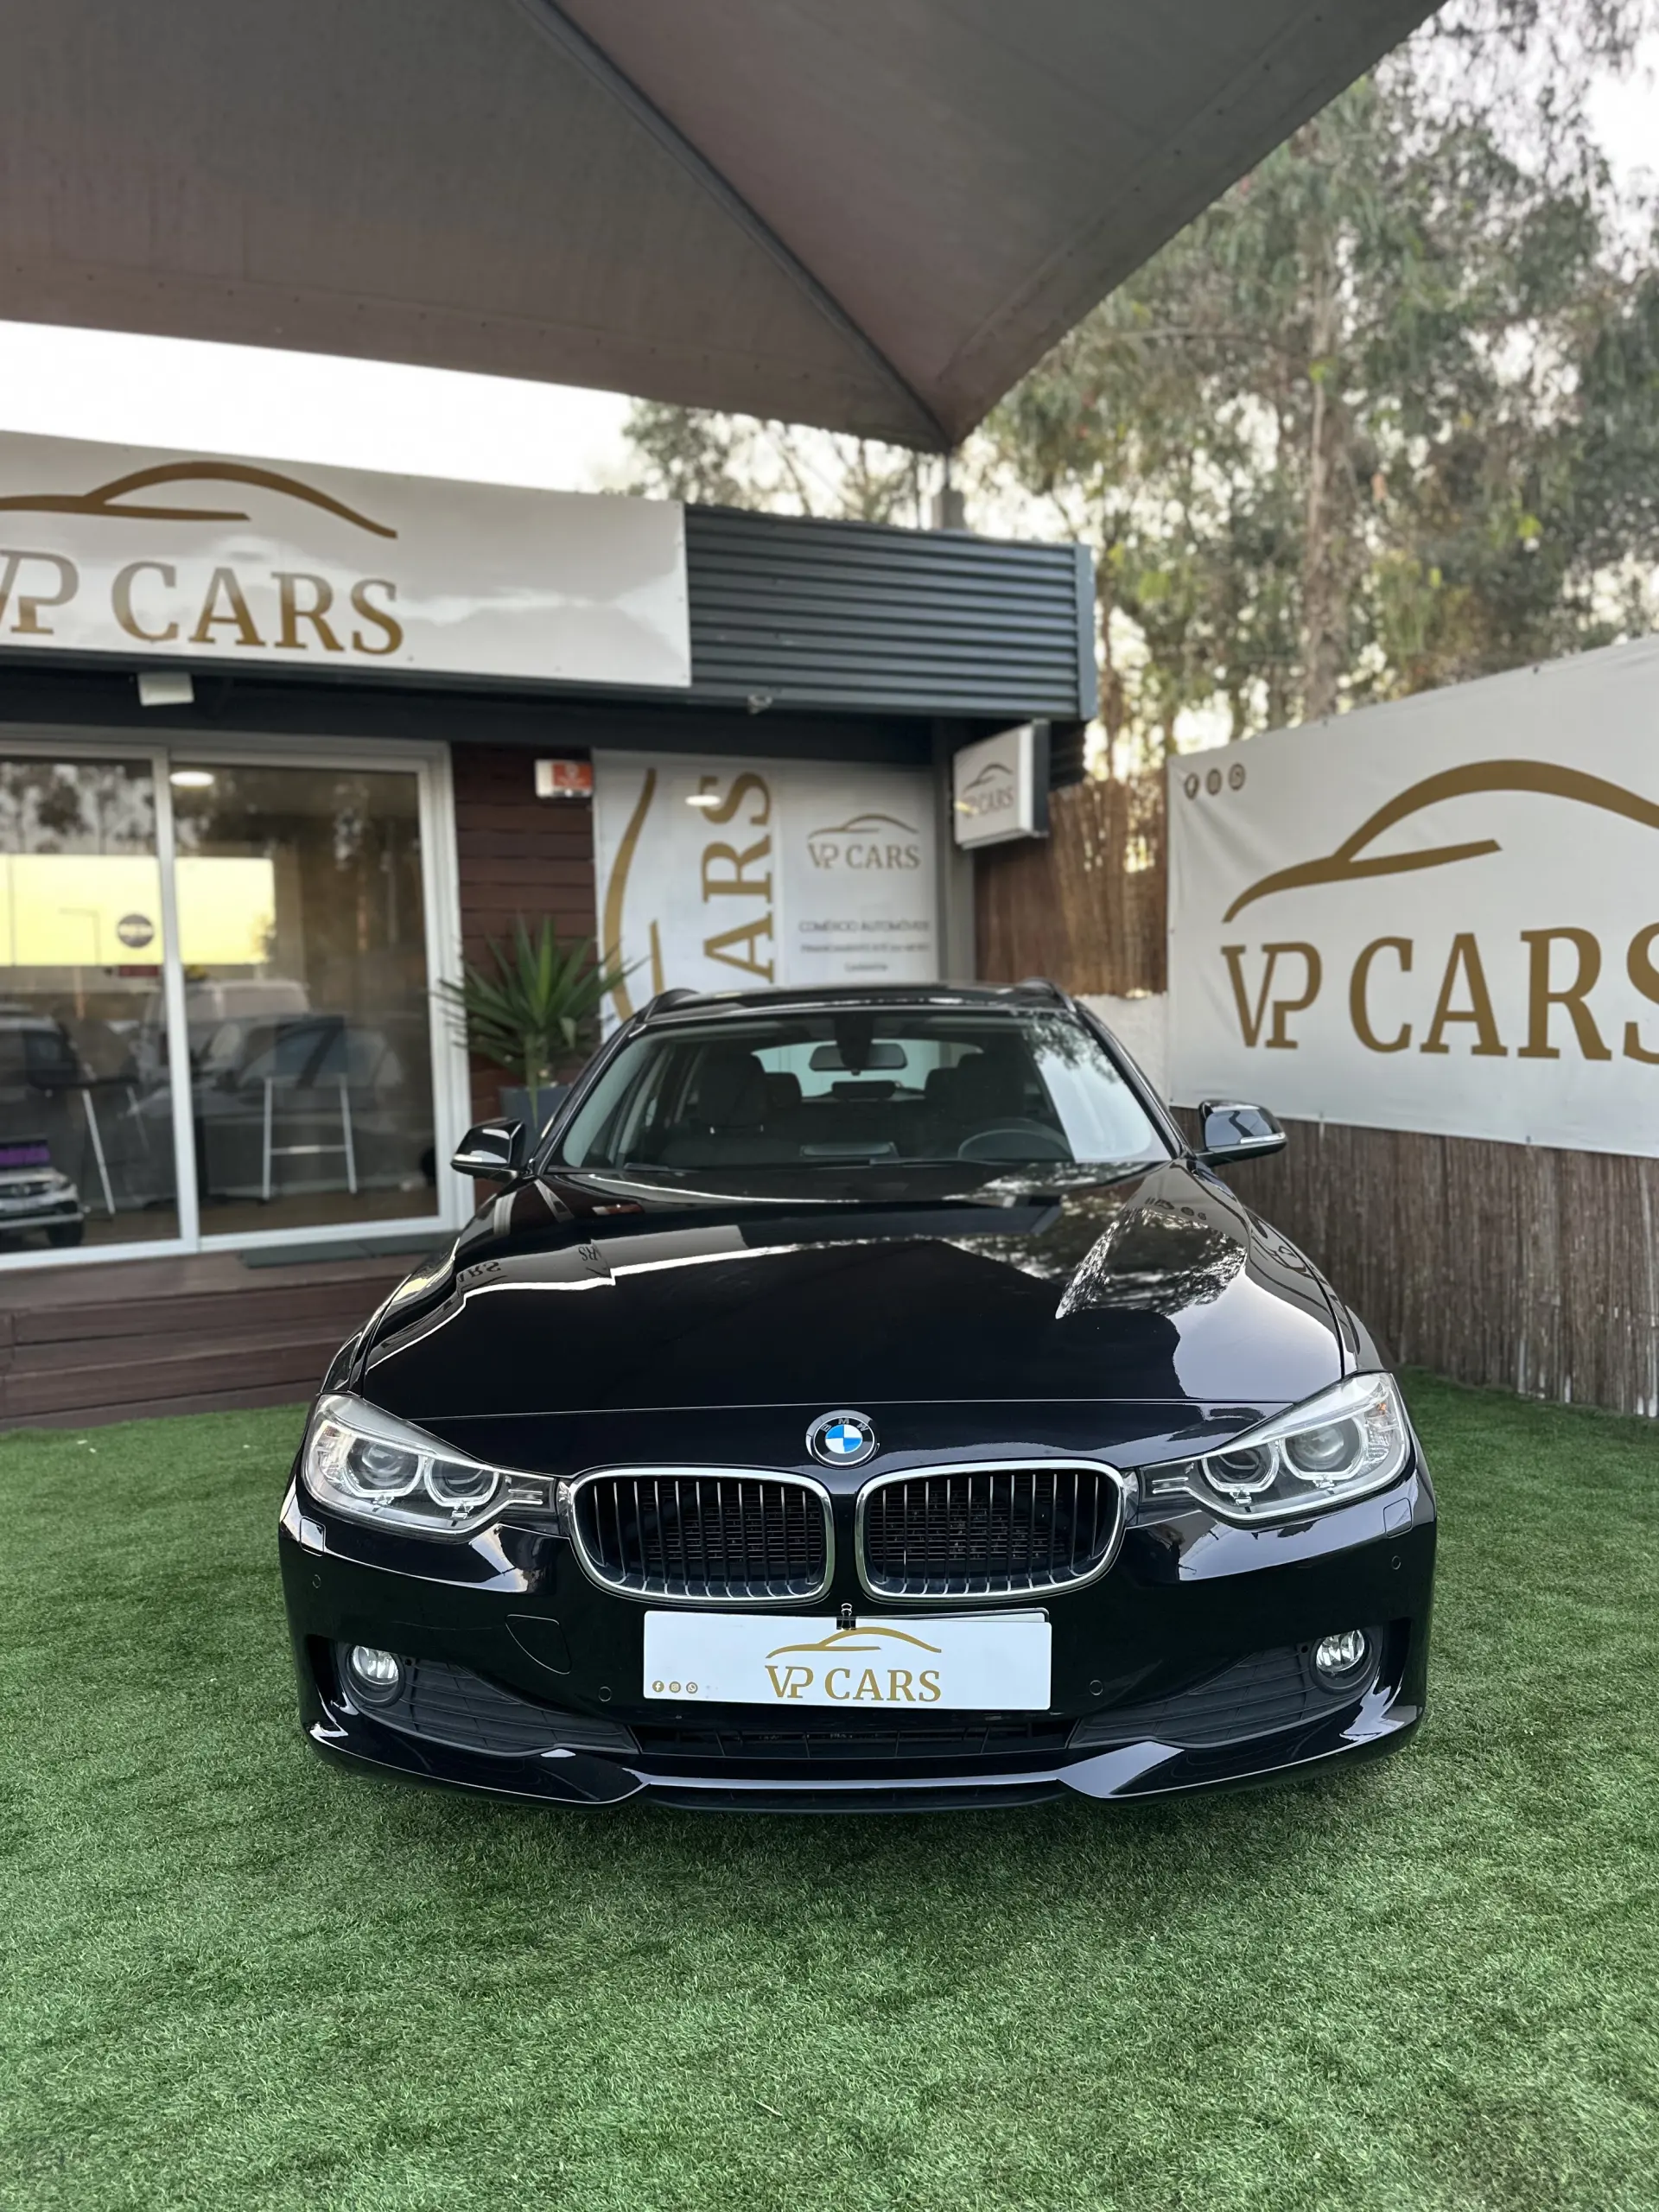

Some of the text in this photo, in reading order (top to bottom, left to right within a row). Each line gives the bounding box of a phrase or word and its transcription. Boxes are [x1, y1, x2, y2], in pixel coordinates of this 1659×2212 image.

[111, 561, 404, 655] CARS
[699, 772, 773, 984] ARS
[808, 843, 921, 869] VP CARS
[1221, 942, 1322, 1049] VP
[765, 1665, 941, 1702] VP CARS
